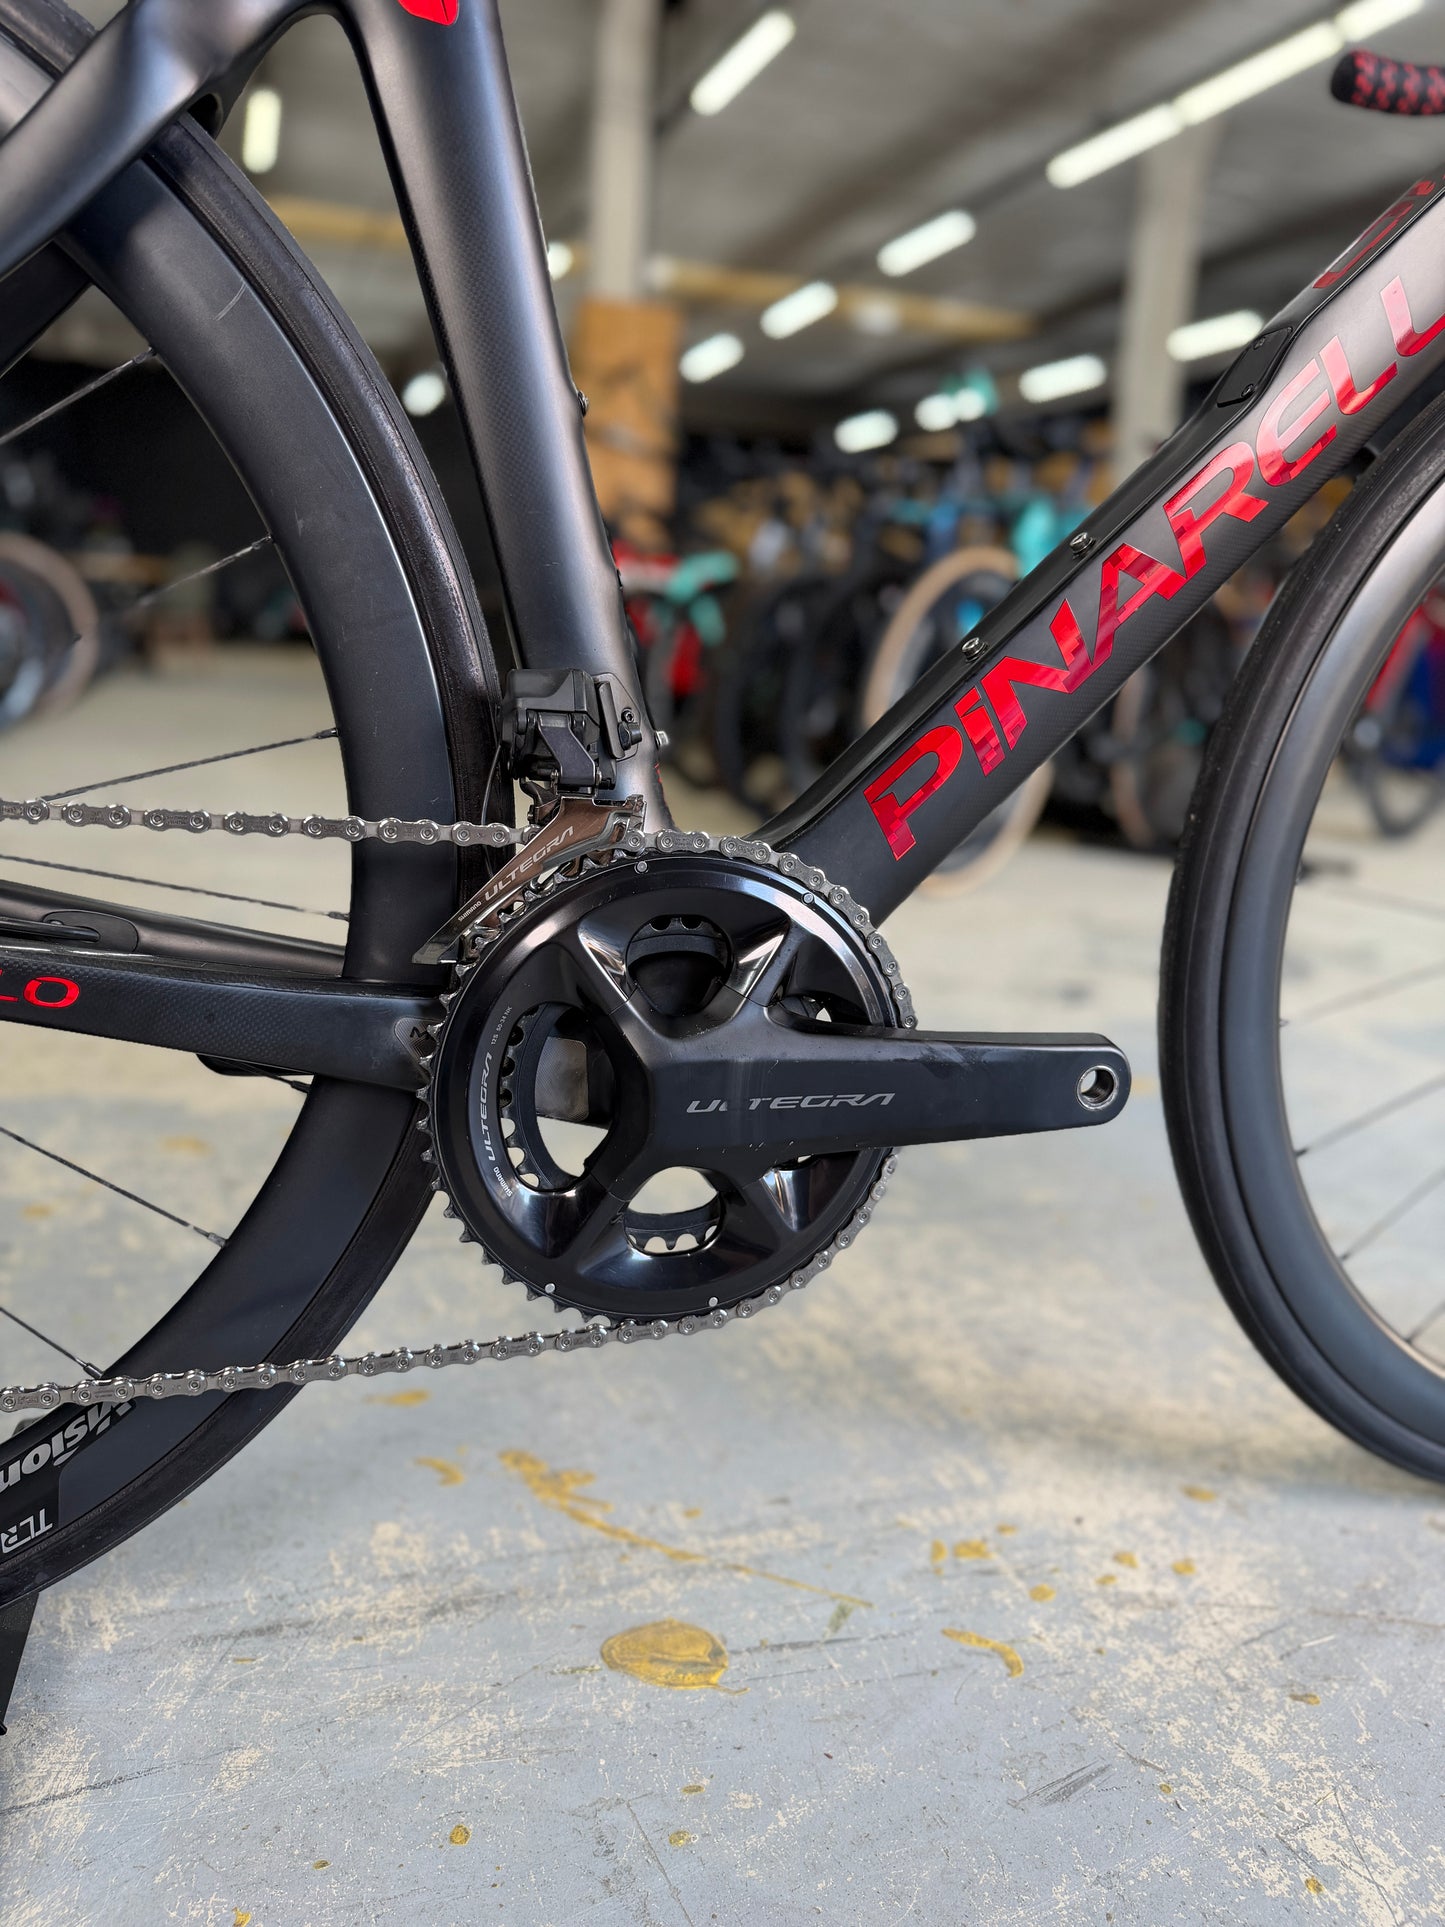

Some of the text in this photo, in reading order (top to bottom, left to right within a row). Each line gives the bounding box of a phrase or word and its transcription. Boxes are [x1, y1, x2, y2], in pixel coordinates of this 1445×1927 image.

[458, 826, 573, 921] SHIMANO ULTEGRA
[480, 1052, 496, 1161] ULTEGRA
[493, 1166, 513, 1197] SHIMANO
[0, 1508, 53, 1553] TLR
